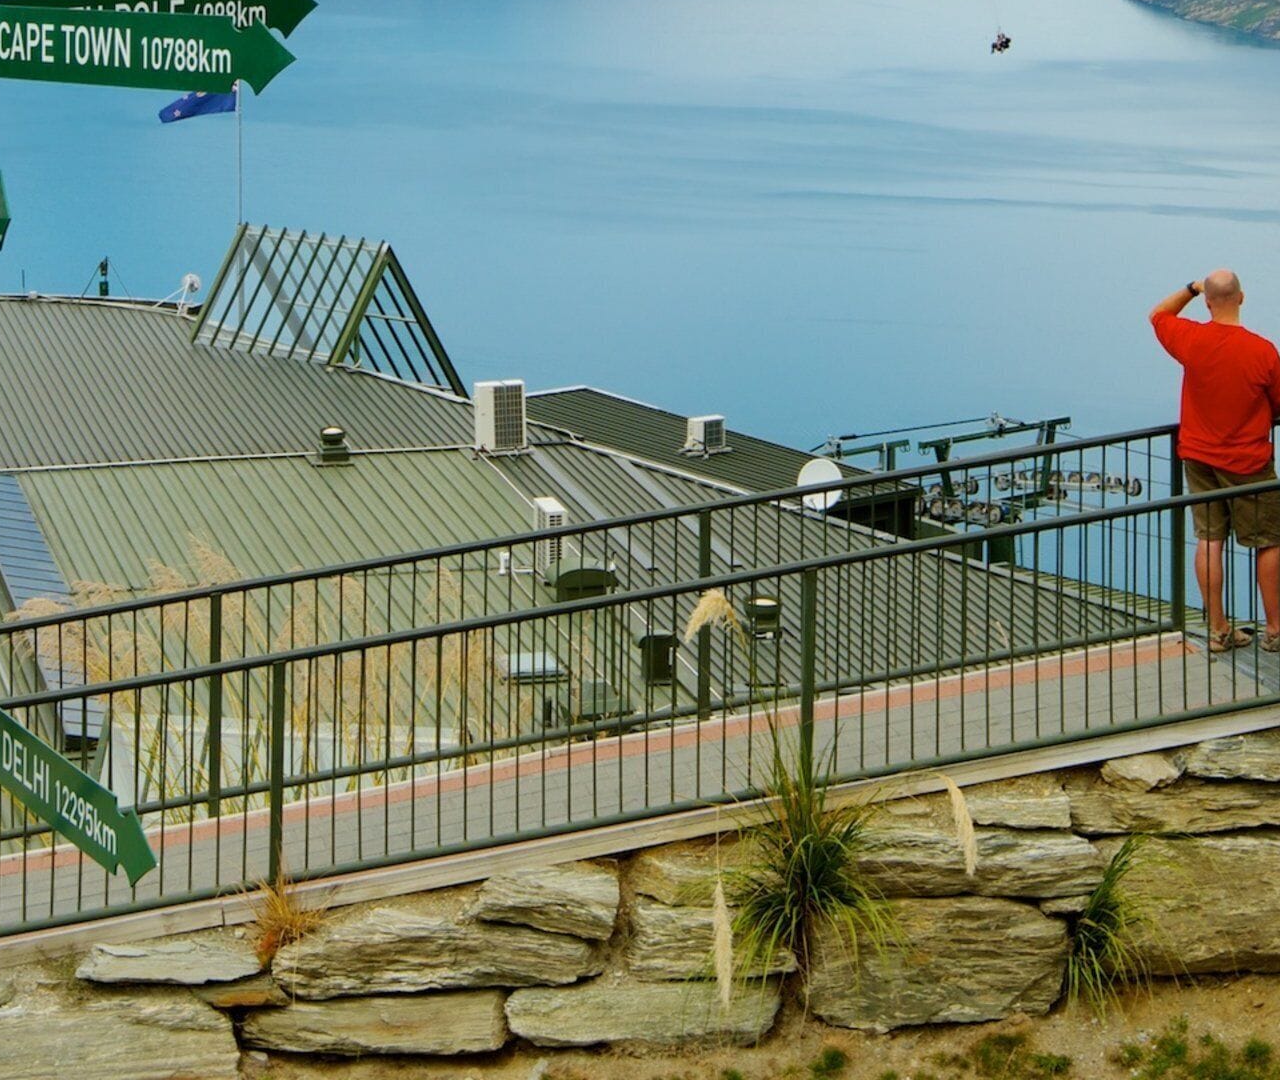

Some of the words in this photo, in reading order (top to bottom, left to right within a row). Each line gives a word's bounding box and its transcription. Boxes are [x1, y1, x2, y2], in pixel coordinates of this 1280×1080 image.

[60, 24, 131, 68] TOWN
[141, 36, 232, 74] 10788km
[1, 729, 50, 803] DELHI
[55, 776, 117, 855] 12295km
